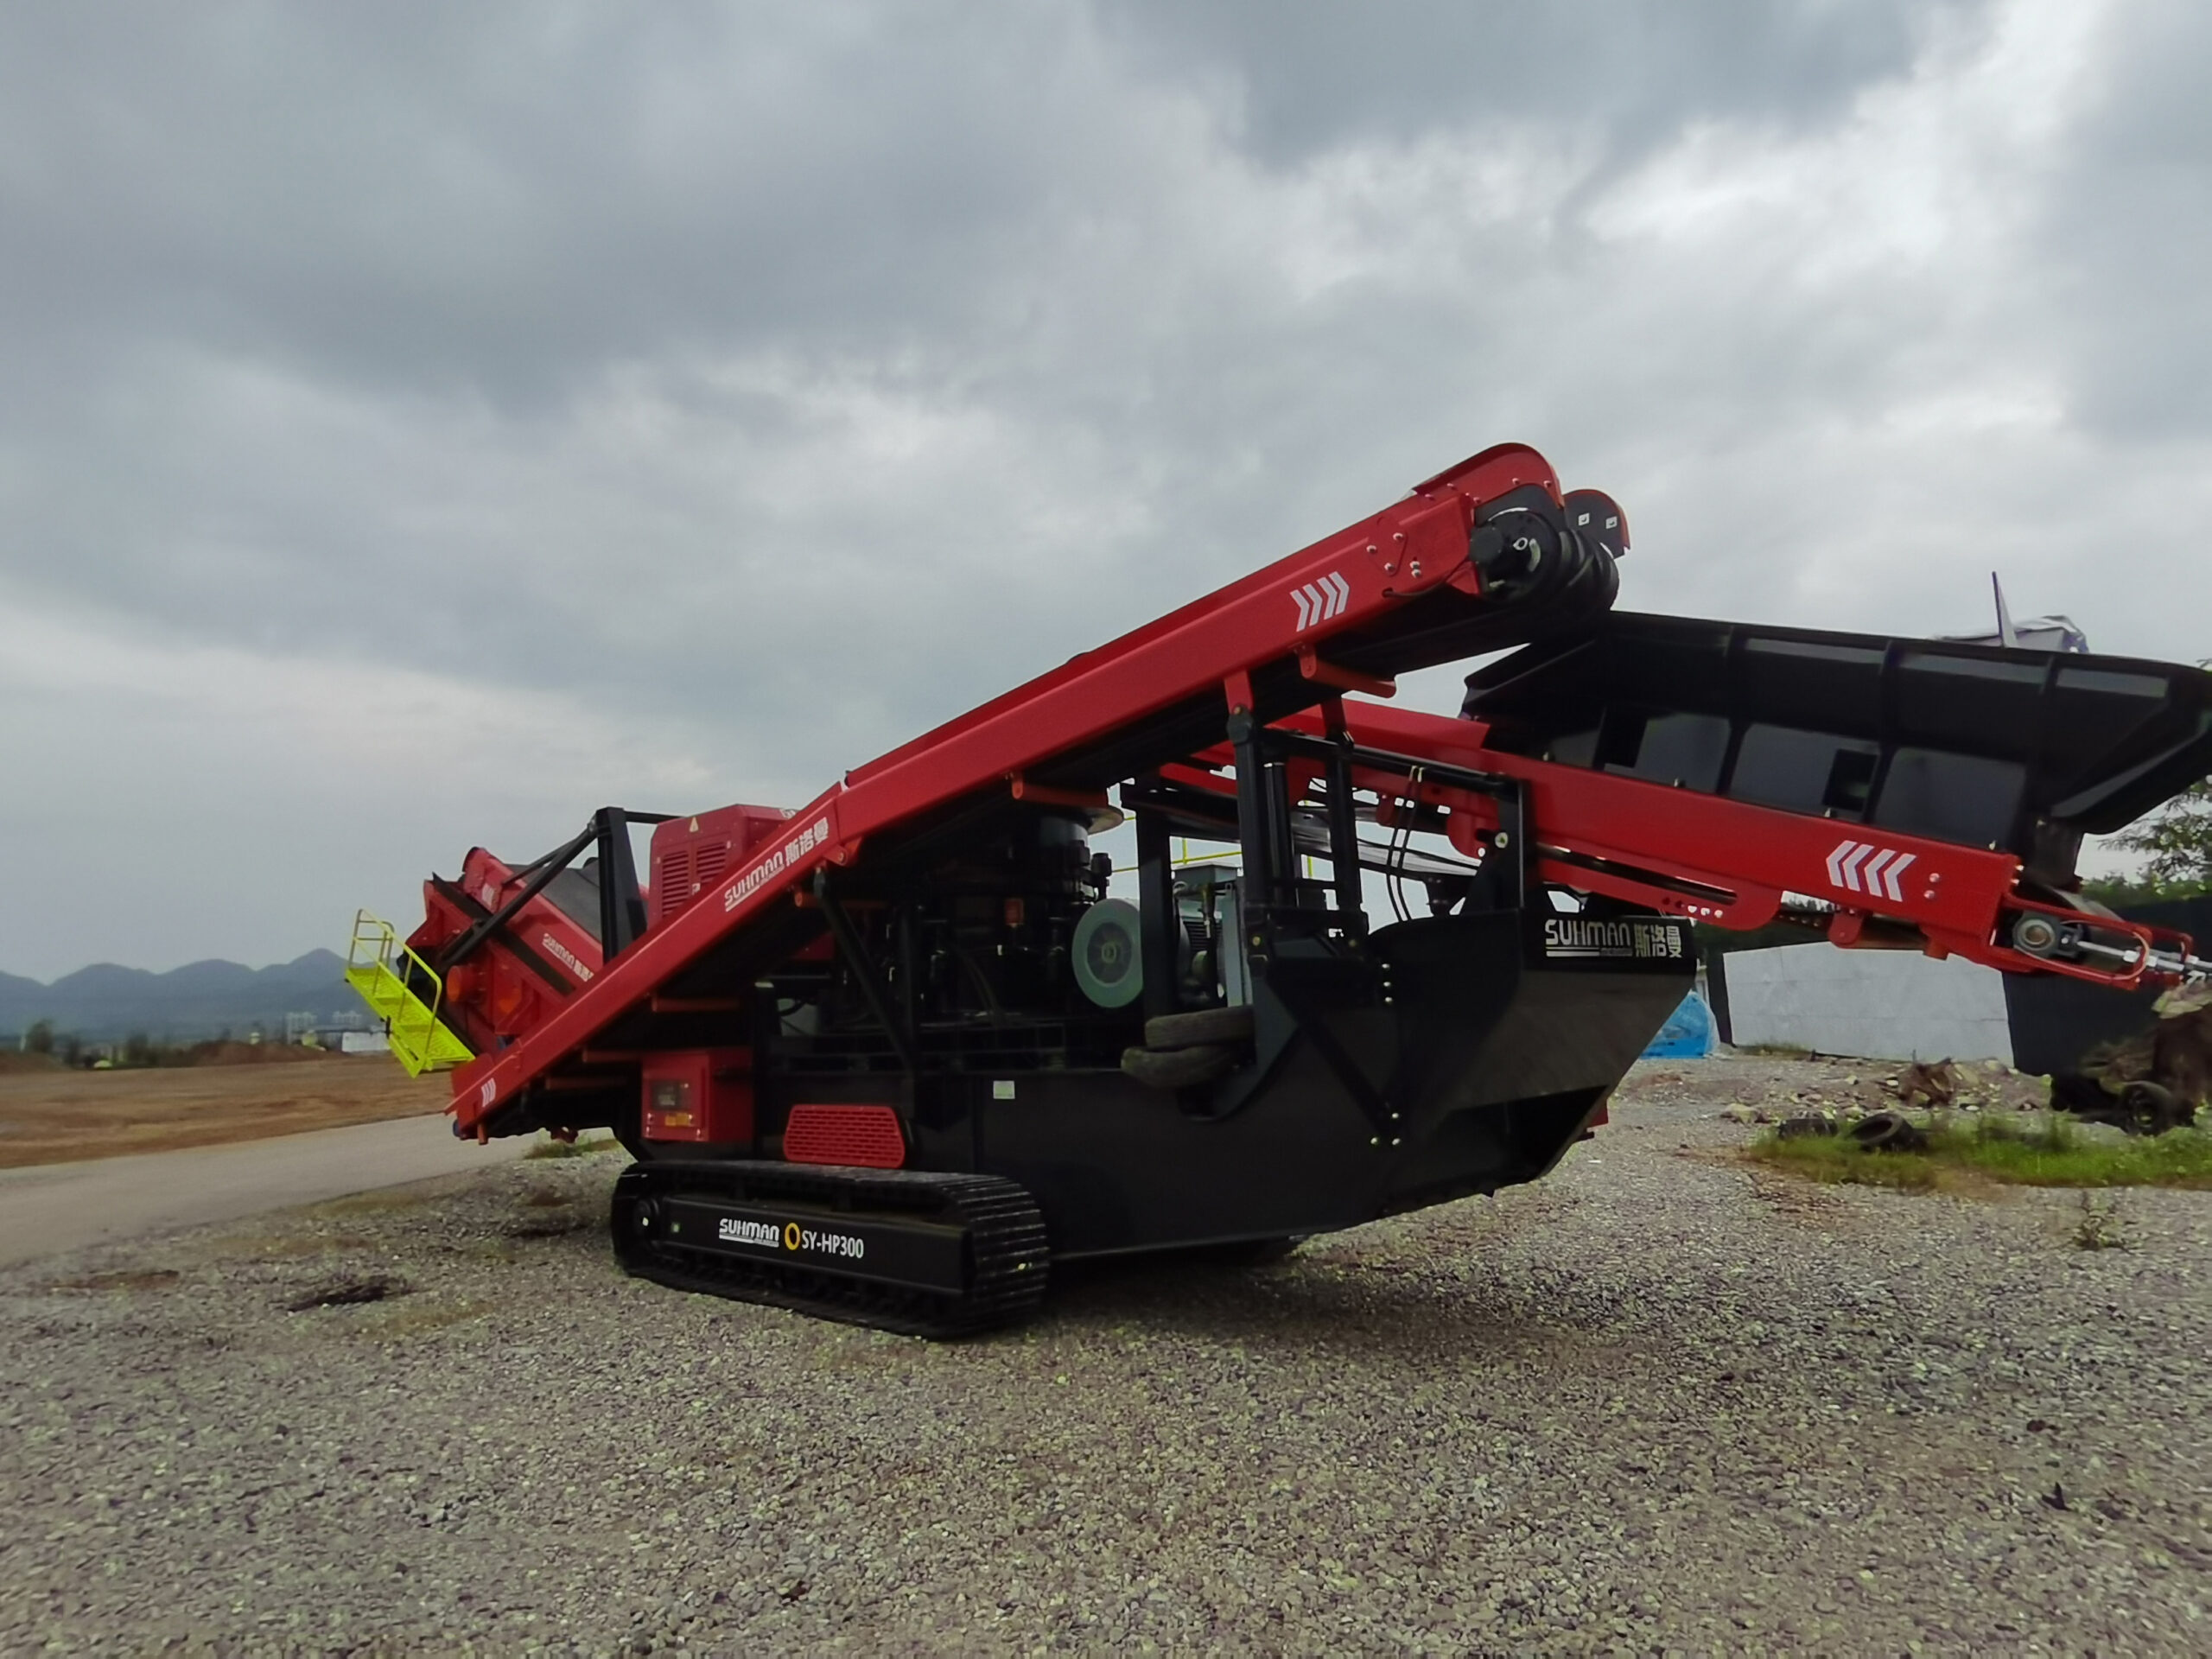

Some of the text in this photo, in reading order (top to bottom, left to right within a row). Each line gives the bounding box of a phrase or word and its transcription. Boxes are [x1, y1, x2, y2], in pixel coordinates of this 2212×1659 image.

[724, 817, 829, 907] SUHMAN 斯洛曼
[1545, 919, 1682, 958] SUHMAN 斯洛曼
[719, 1218, 779, 1242] SUHMAN
